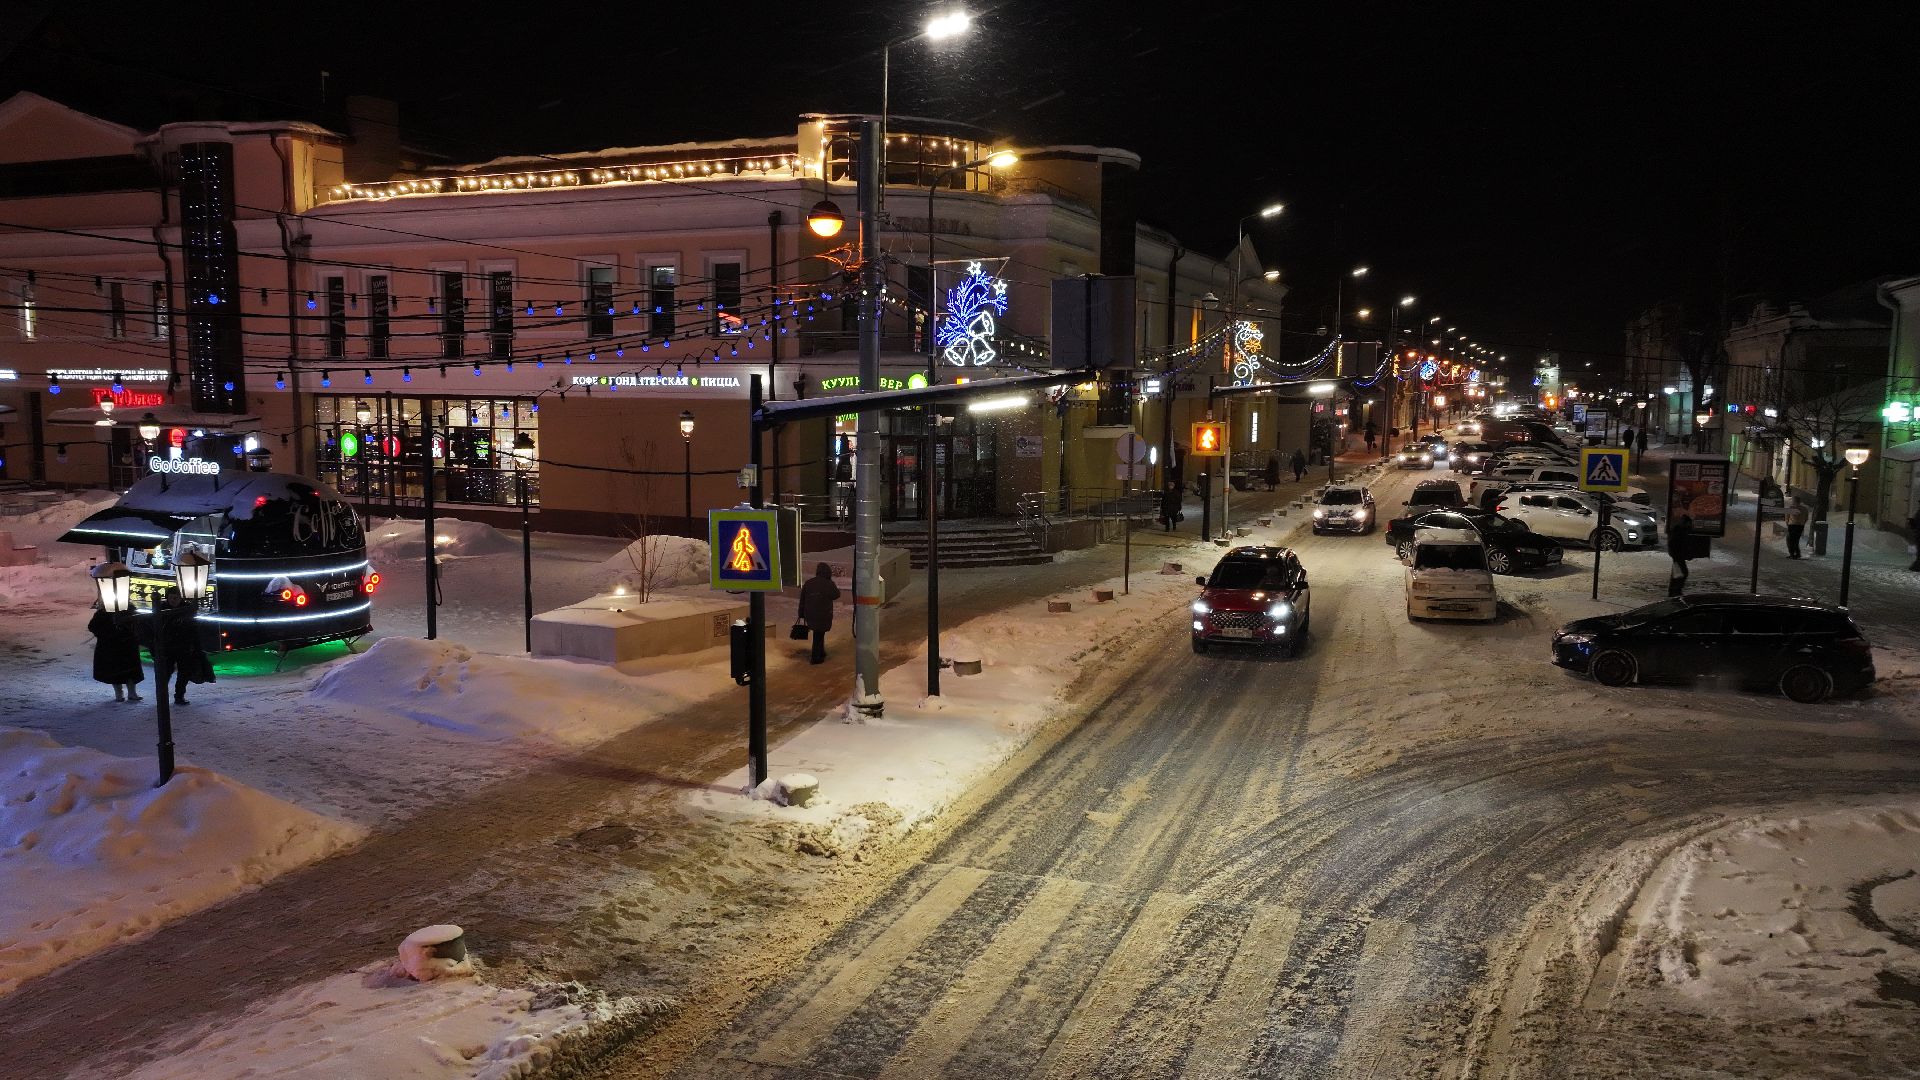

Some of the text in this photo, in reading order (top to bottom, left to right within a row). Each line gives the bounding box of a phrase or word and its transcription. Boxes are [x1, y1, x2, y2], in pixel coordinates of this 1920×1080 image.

[572, 376, 598, 386] КОФЕ
[700, 376, 740, 388] ПИЦЦА
[821, 376, 903, 390] КУУЛКВЕР
